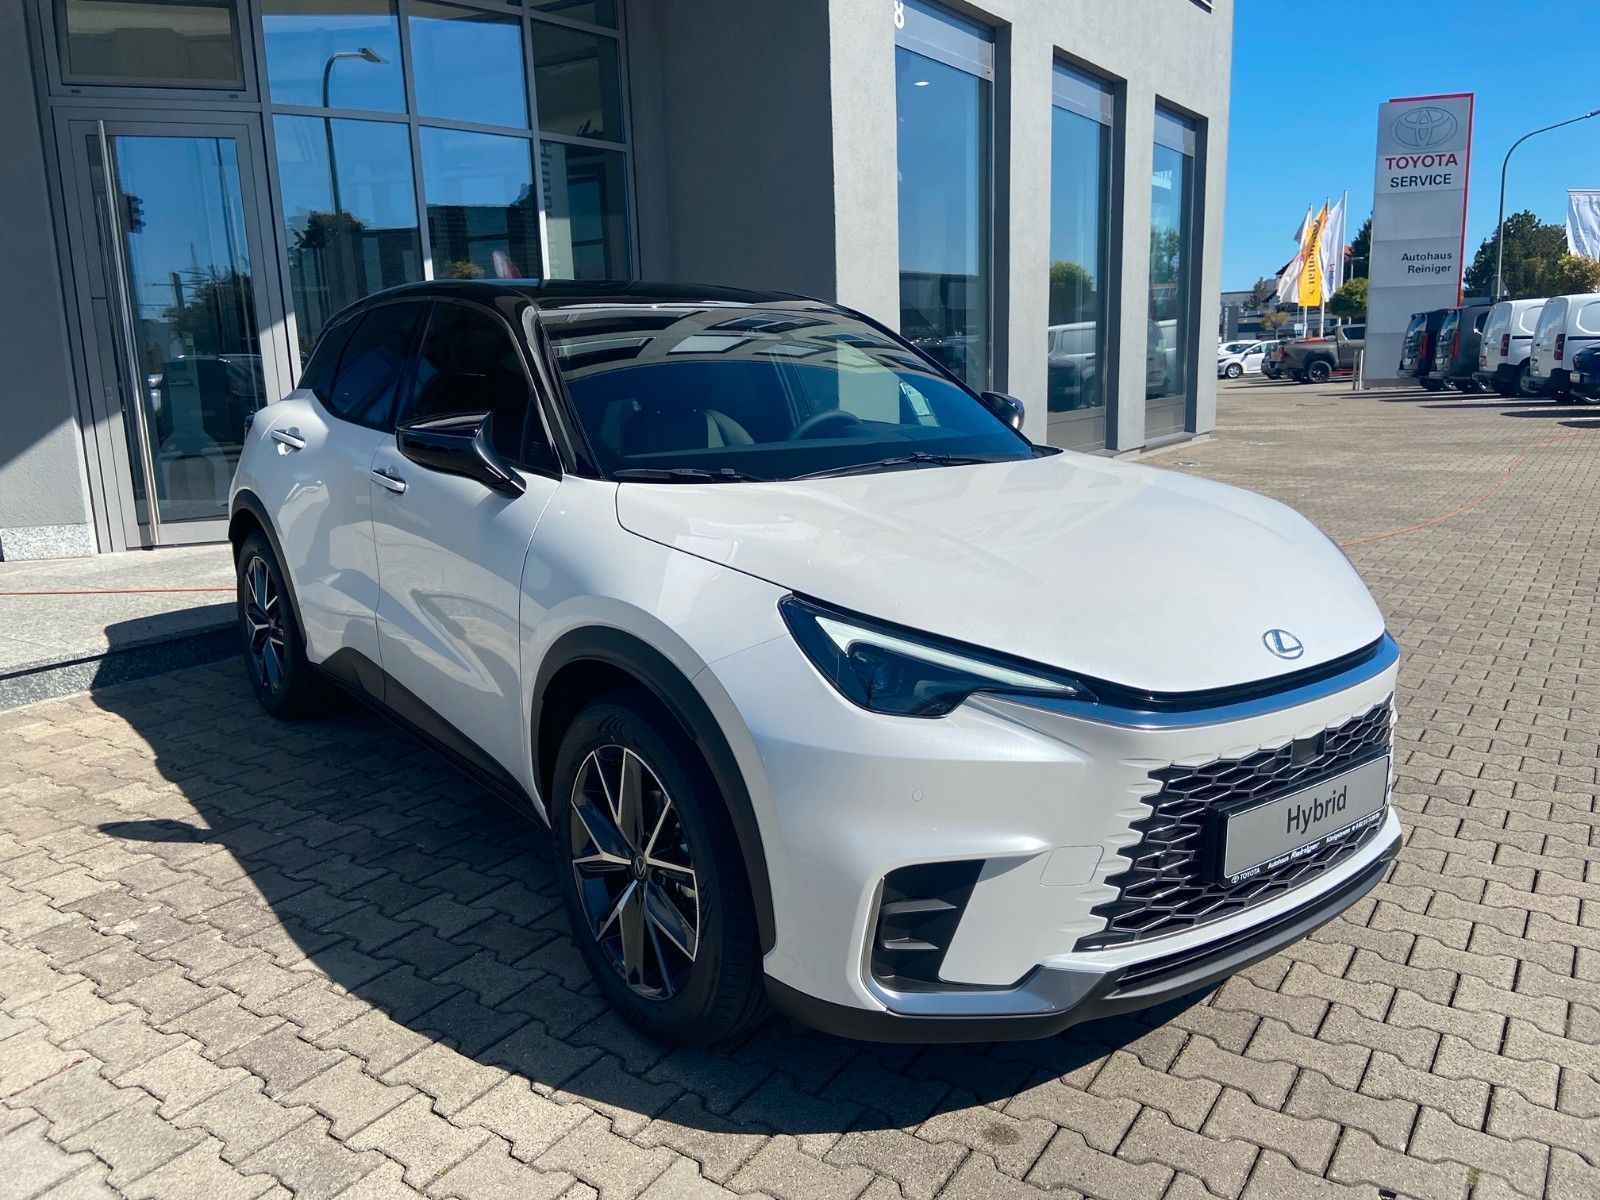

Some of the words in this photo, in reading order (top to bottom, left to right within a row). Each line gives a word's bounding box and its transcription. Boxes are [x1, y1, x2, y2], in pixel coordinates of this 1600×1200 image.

[1385, 153, 1458, 170] TOYOTA
[1390, 173, 1452, 188] SERVICE
[1401, 251, 1453, 262] Autohaus
[1407, 264, 1452, 275] Reiniger
[1286, 785, 1348, 835] Hybrid
